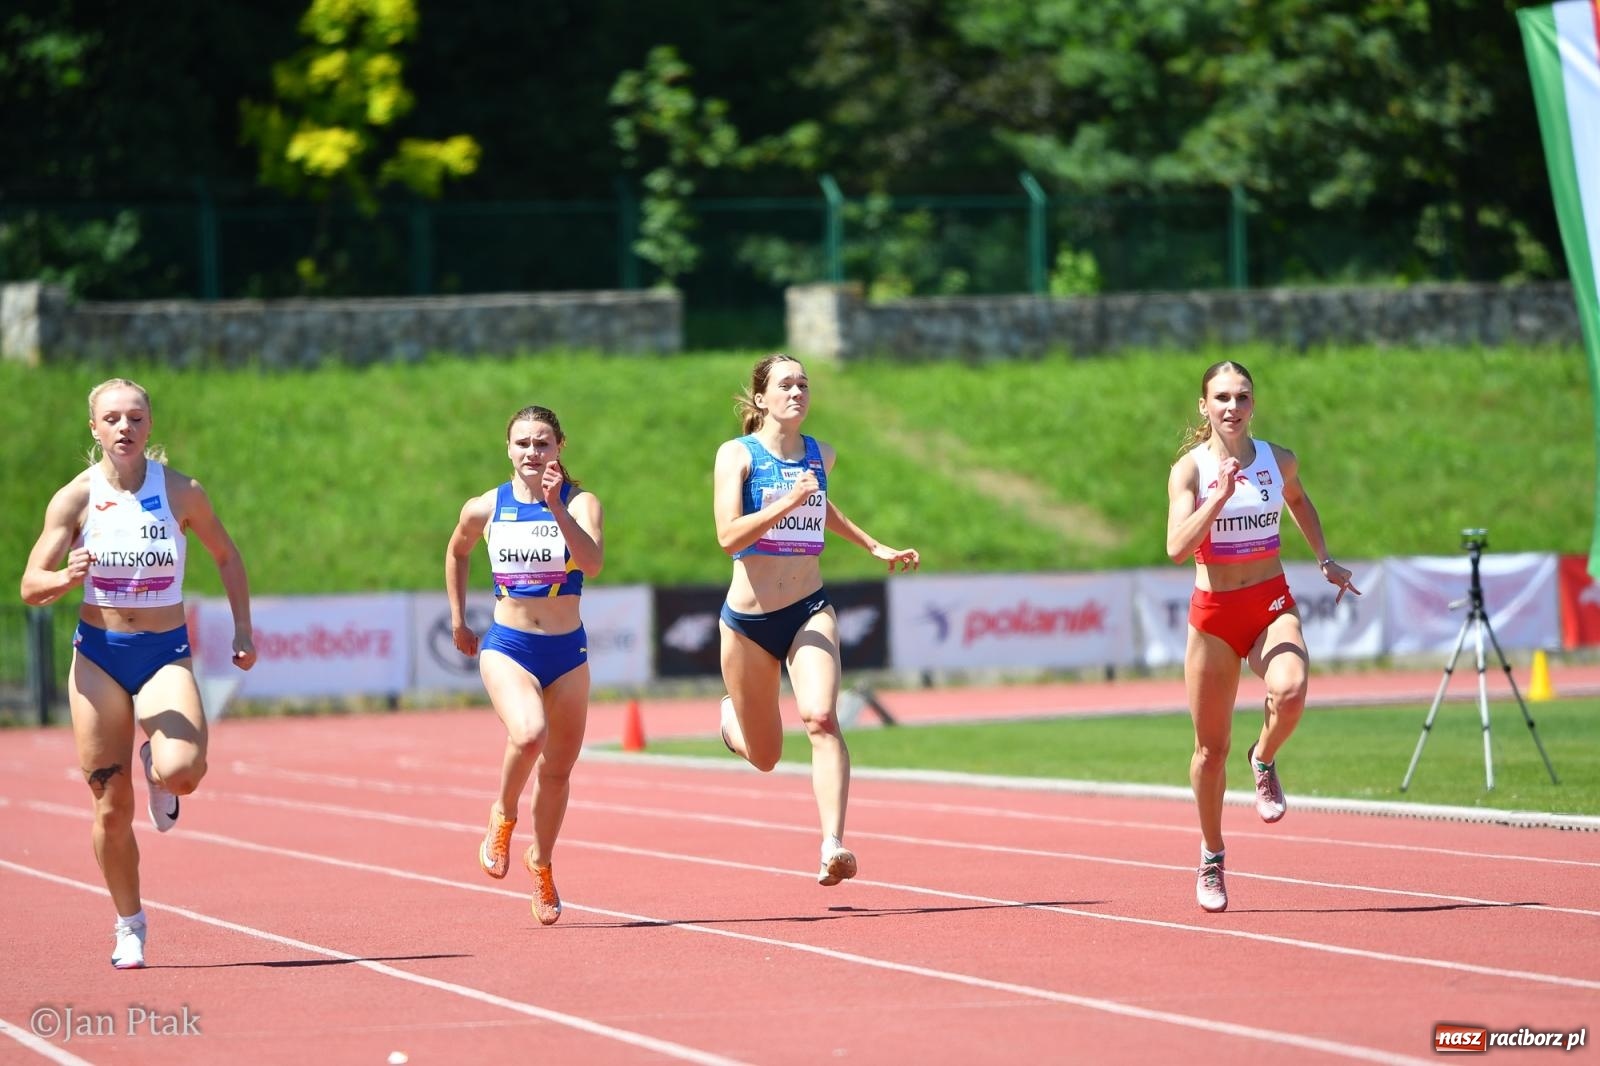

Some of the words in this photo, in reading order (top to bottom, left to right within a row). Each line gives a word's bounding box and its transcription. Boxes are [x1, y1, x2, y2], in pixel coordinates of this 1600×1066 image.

[1260, 489, 1270, 502] 3
[1215, 511, 1279, 532] TITTINGER
[140, 525, 168, 540] 101
[531, 525, 559, 538] 403
[499, 548, 552, 563] SHVAB
[1268, 595, 1286, 612] 4F
[963, 598, 1108, 647] polanik
